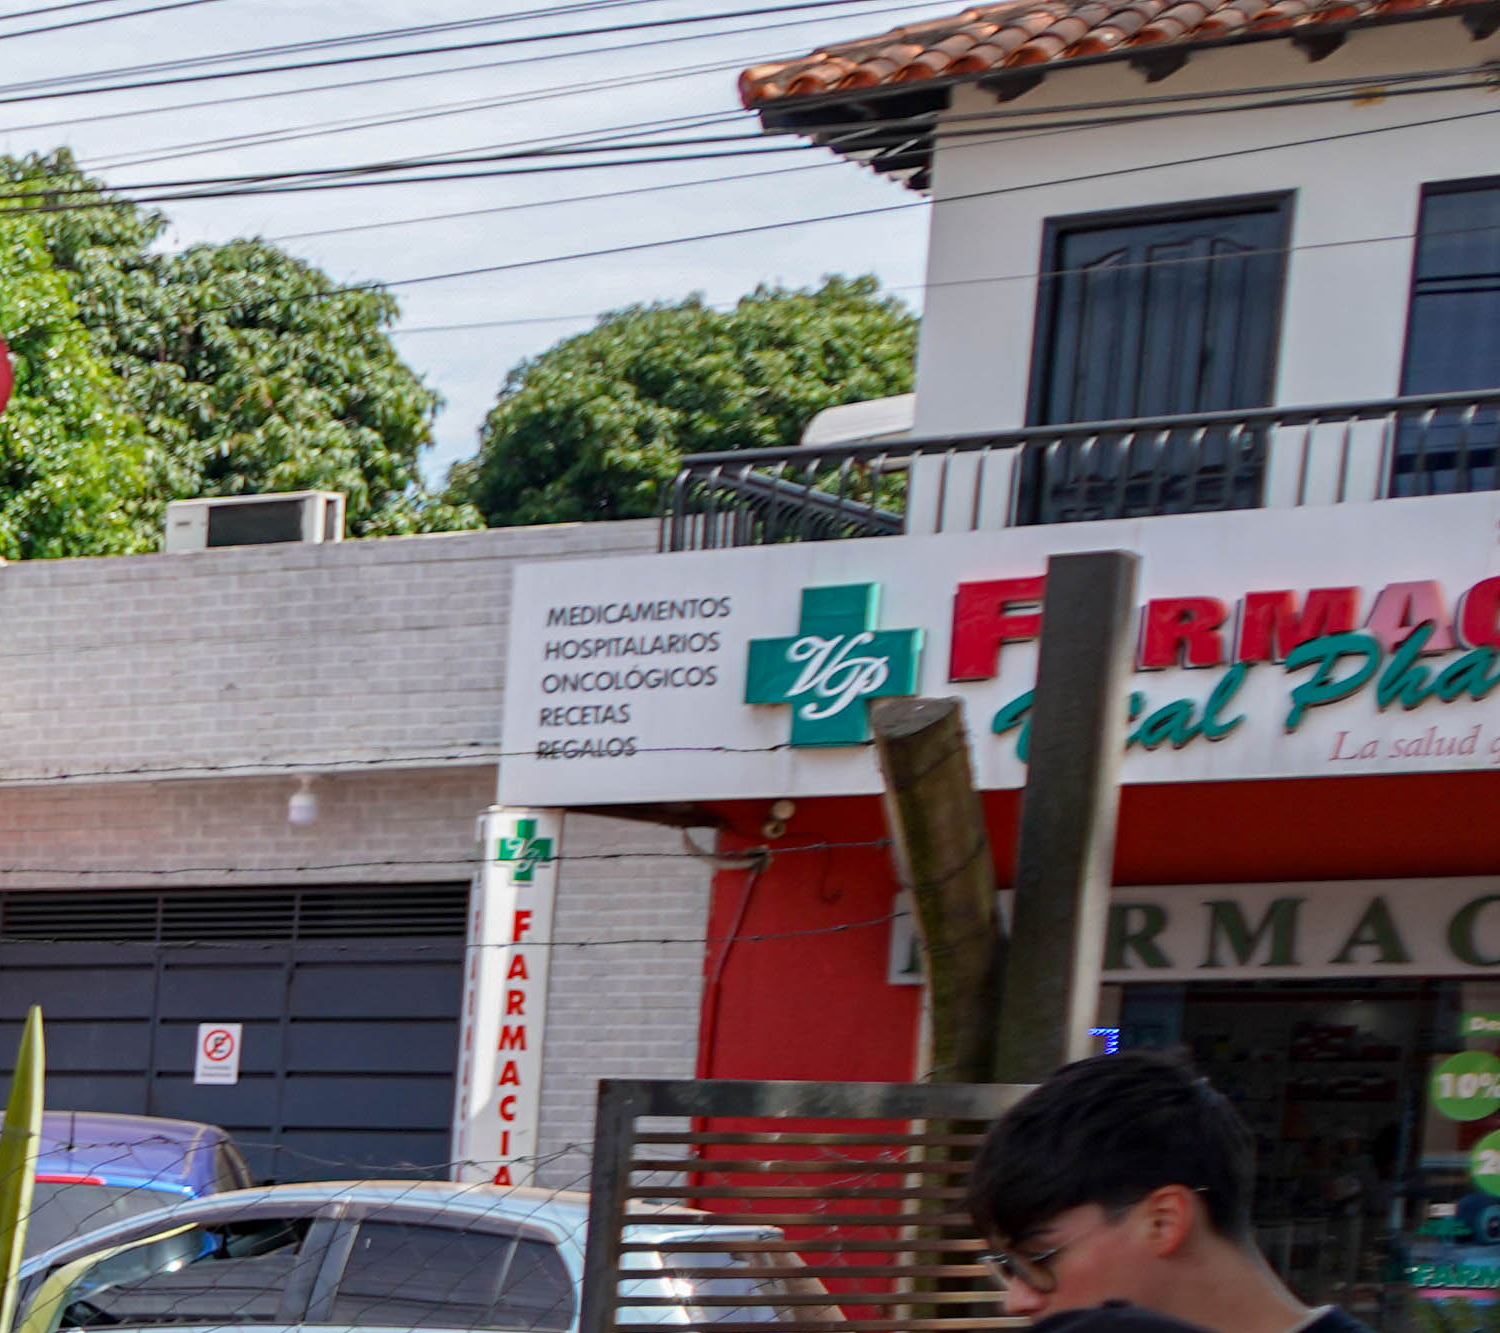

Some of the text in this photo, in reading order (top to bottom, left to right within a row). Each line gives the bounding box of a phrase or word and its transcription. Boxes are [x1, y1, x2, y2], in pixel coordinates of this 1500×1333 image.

[546, 596, 732, 628] MEDICAMENTOS
[948, 575, 1500, 682] FRMA
[543, 630, 721, 661] HOSPITALARIOS
[541, 663, 719, 694] ONCOLÓGICOS
[538, 702, 632, 727] RECETAS
[535, 735, 639, 760] REGALOS
[1329, 730, 1380, 762] La
[1386, 723, 1483, 759] salud
[493, 909, 534, 1187] FARMACIA
